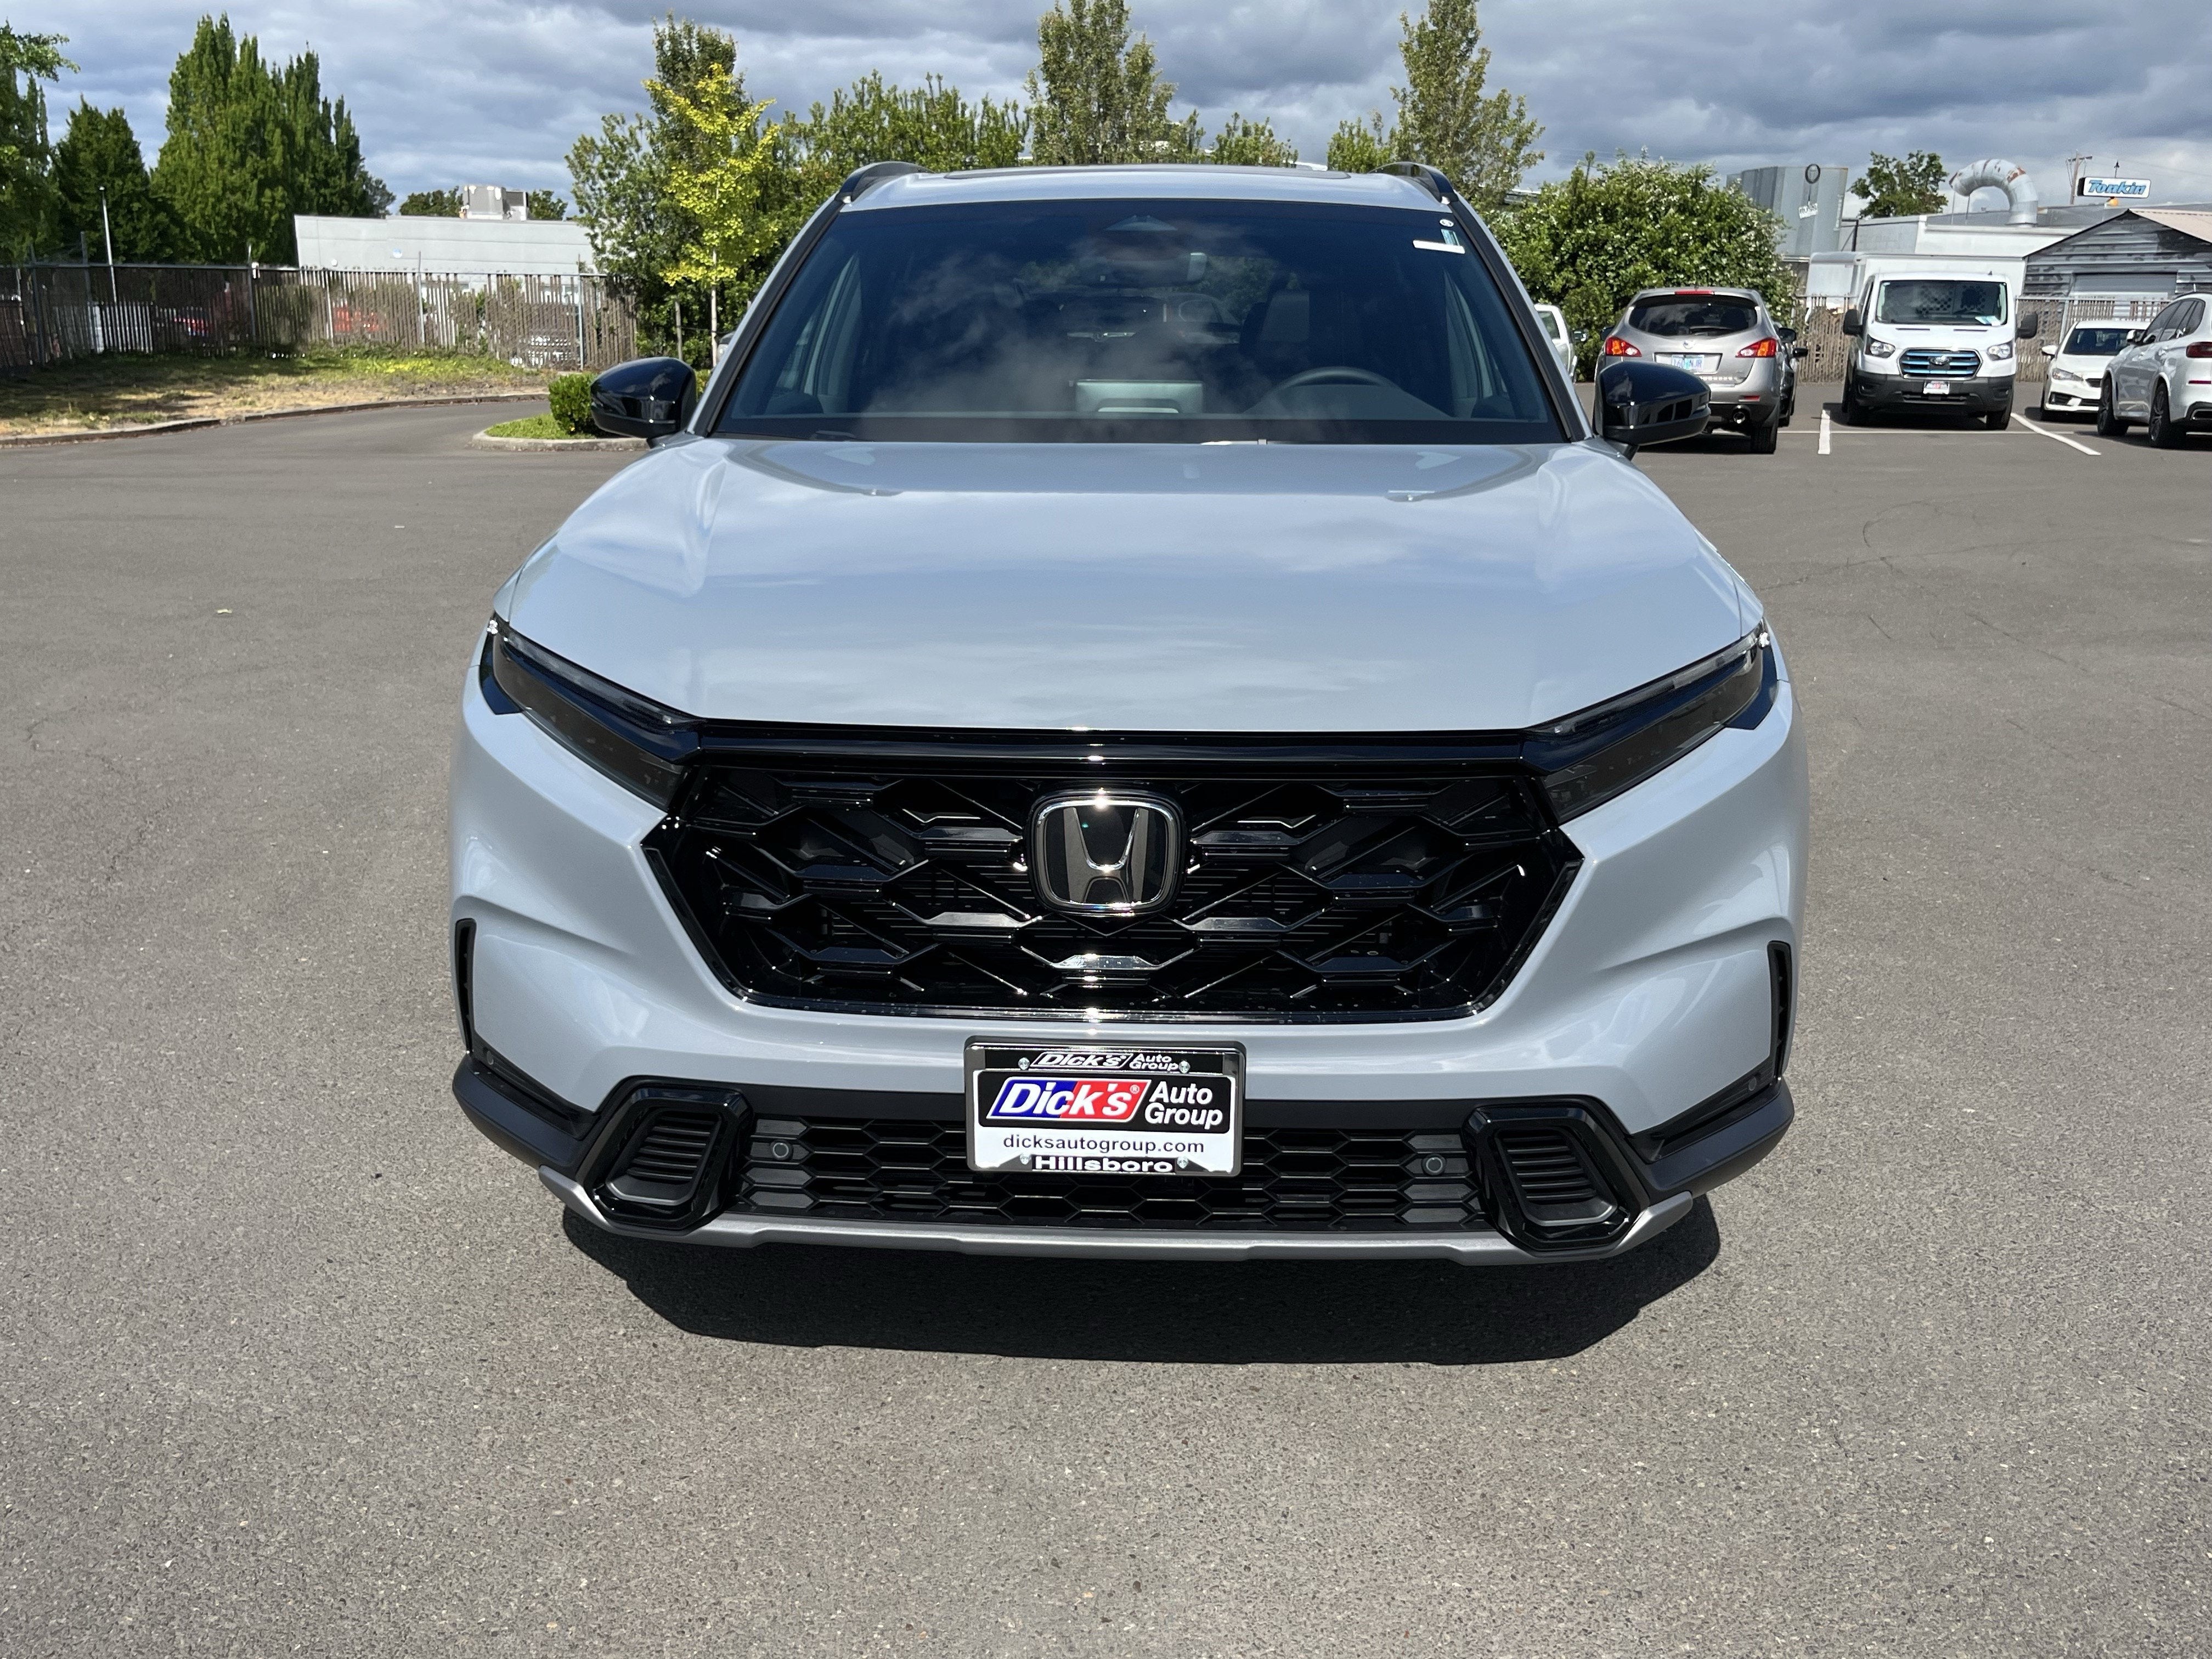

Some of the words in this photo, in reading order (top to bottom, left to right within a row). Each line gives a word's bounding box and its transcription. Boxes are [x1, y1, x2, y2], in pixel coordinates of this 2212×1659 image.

[2089, 180, 2146, 195] Tonkin
[1037, 1053, 1121, 1066] Dick's
[1129, 1061, 1179, 1071] Group
[1133, 1054, 1172, 1063] Auto
[998, 1081, 1131, 1116] Dick's
[1149, 1081, 1213, 1105] Auto
[1145, 1103, 1223, 1129] Group
[1003, 1134, 1204, 1153] dicksautogroup.com
[1035, 1157, 1172, 1172] Hillsboro
